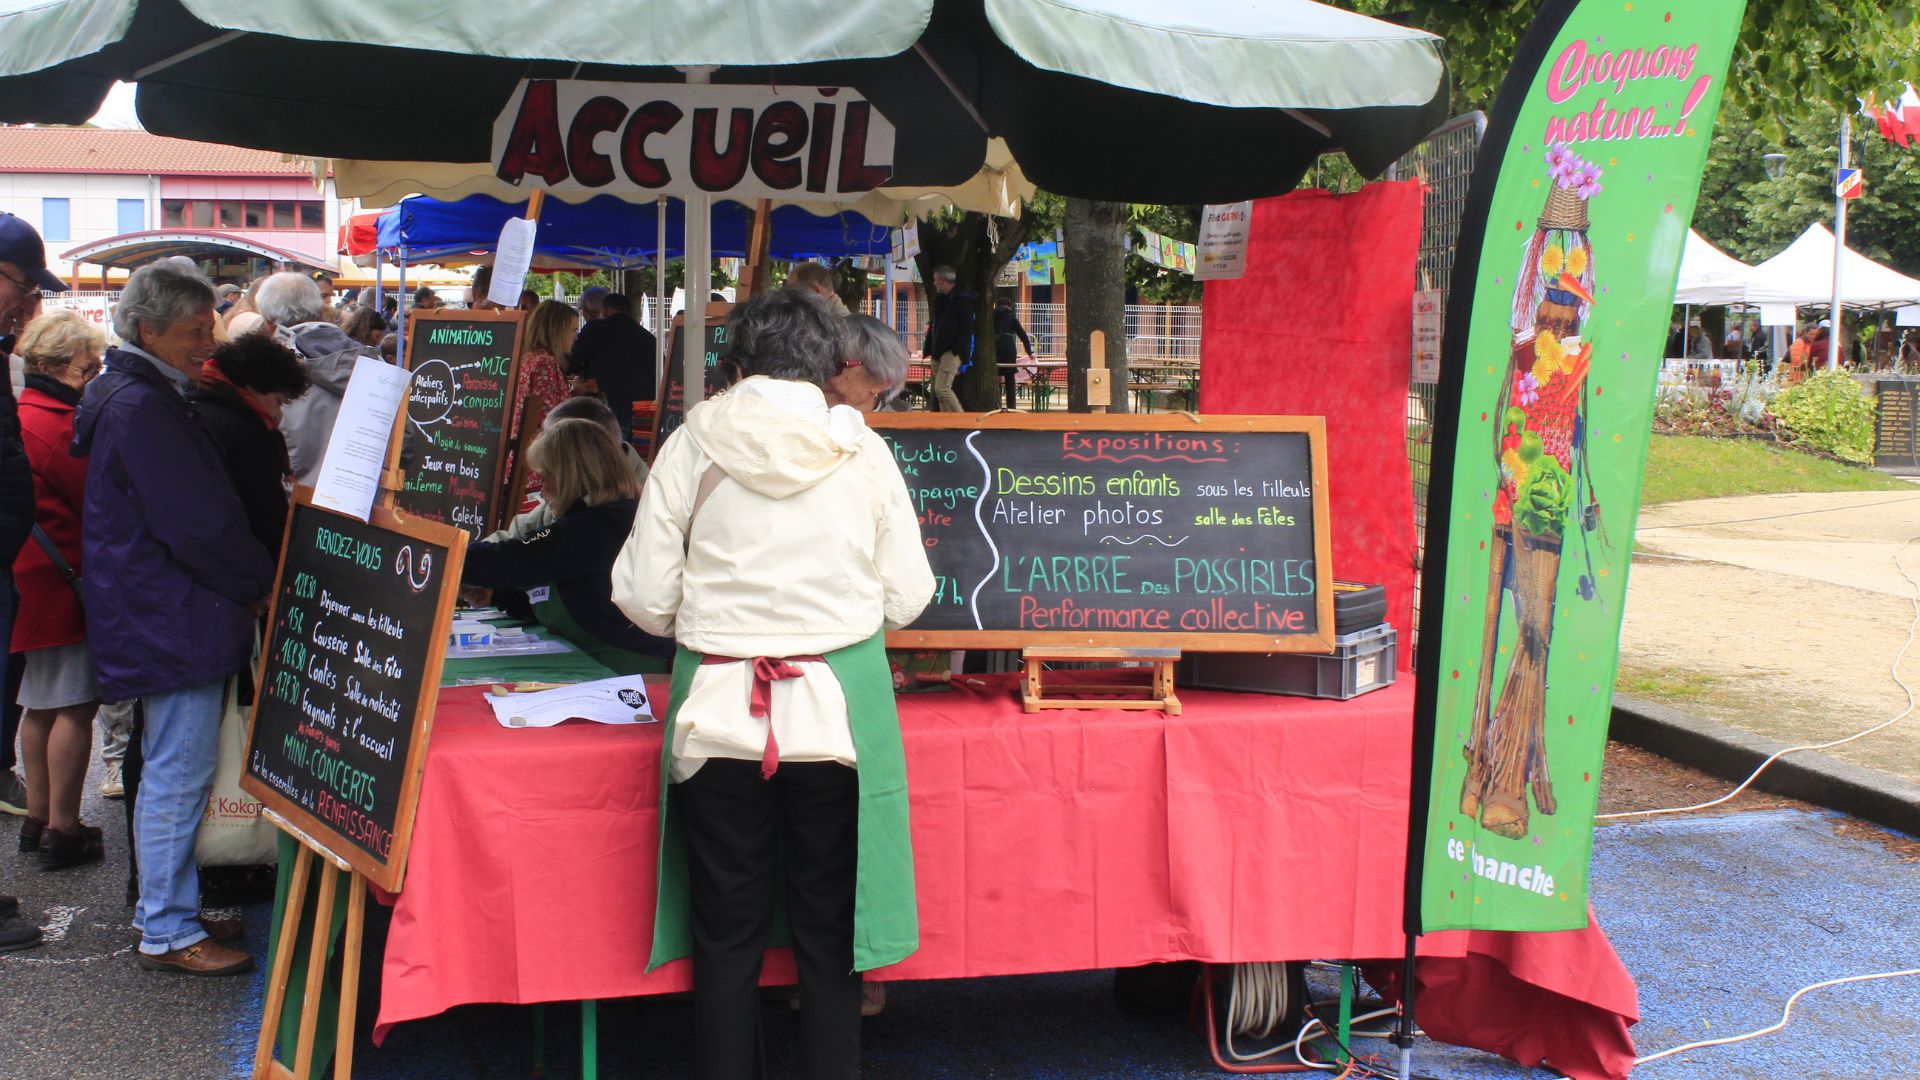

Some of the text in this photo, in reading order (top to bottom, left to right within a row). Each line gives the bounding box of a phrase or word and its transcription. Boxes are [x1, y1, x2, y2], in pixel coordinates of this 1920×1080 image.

[1546, 39, 1698, 105] Croquons
[415, 374, 444, 390] Ateliers
[480, 356, 511, 376] MJC
[1063, 432, 1225, 456] Expositions
[404, 472, 443, 494] ini-ferme
[422, 455, 480, 479] Jeux en bois
[904, 464, 919, 476] de
[997, 468, 1311, 498] Dessins enfants sous les tilleuls
[992, 498, 1066, 524] Atelier
[1083, 500, 1163, 536] photos
[1194, 507, 1227, 526] salle
[1231, 514, 1253, 526] des
[315, 527, 382, 570] RENDEZ-VOUS
[1004, 555, 1132, 594] L'ARBRE
[367, 608, 377, 629] les
[377, 613, 404, 639] tilleuls
[1020, 596, 1305, 630] Performance collective
[312, 621, 349, 656] Causerie
[308, 654, 337, 690] Contes
[343, 675, 362, 704] Salle
[302, 687, 337, 730] Gagnants
[342, 717, 350, 738] à
[218, 797, 264, 817] Kokop
[1447, 838, 1555, 897] ce manche
